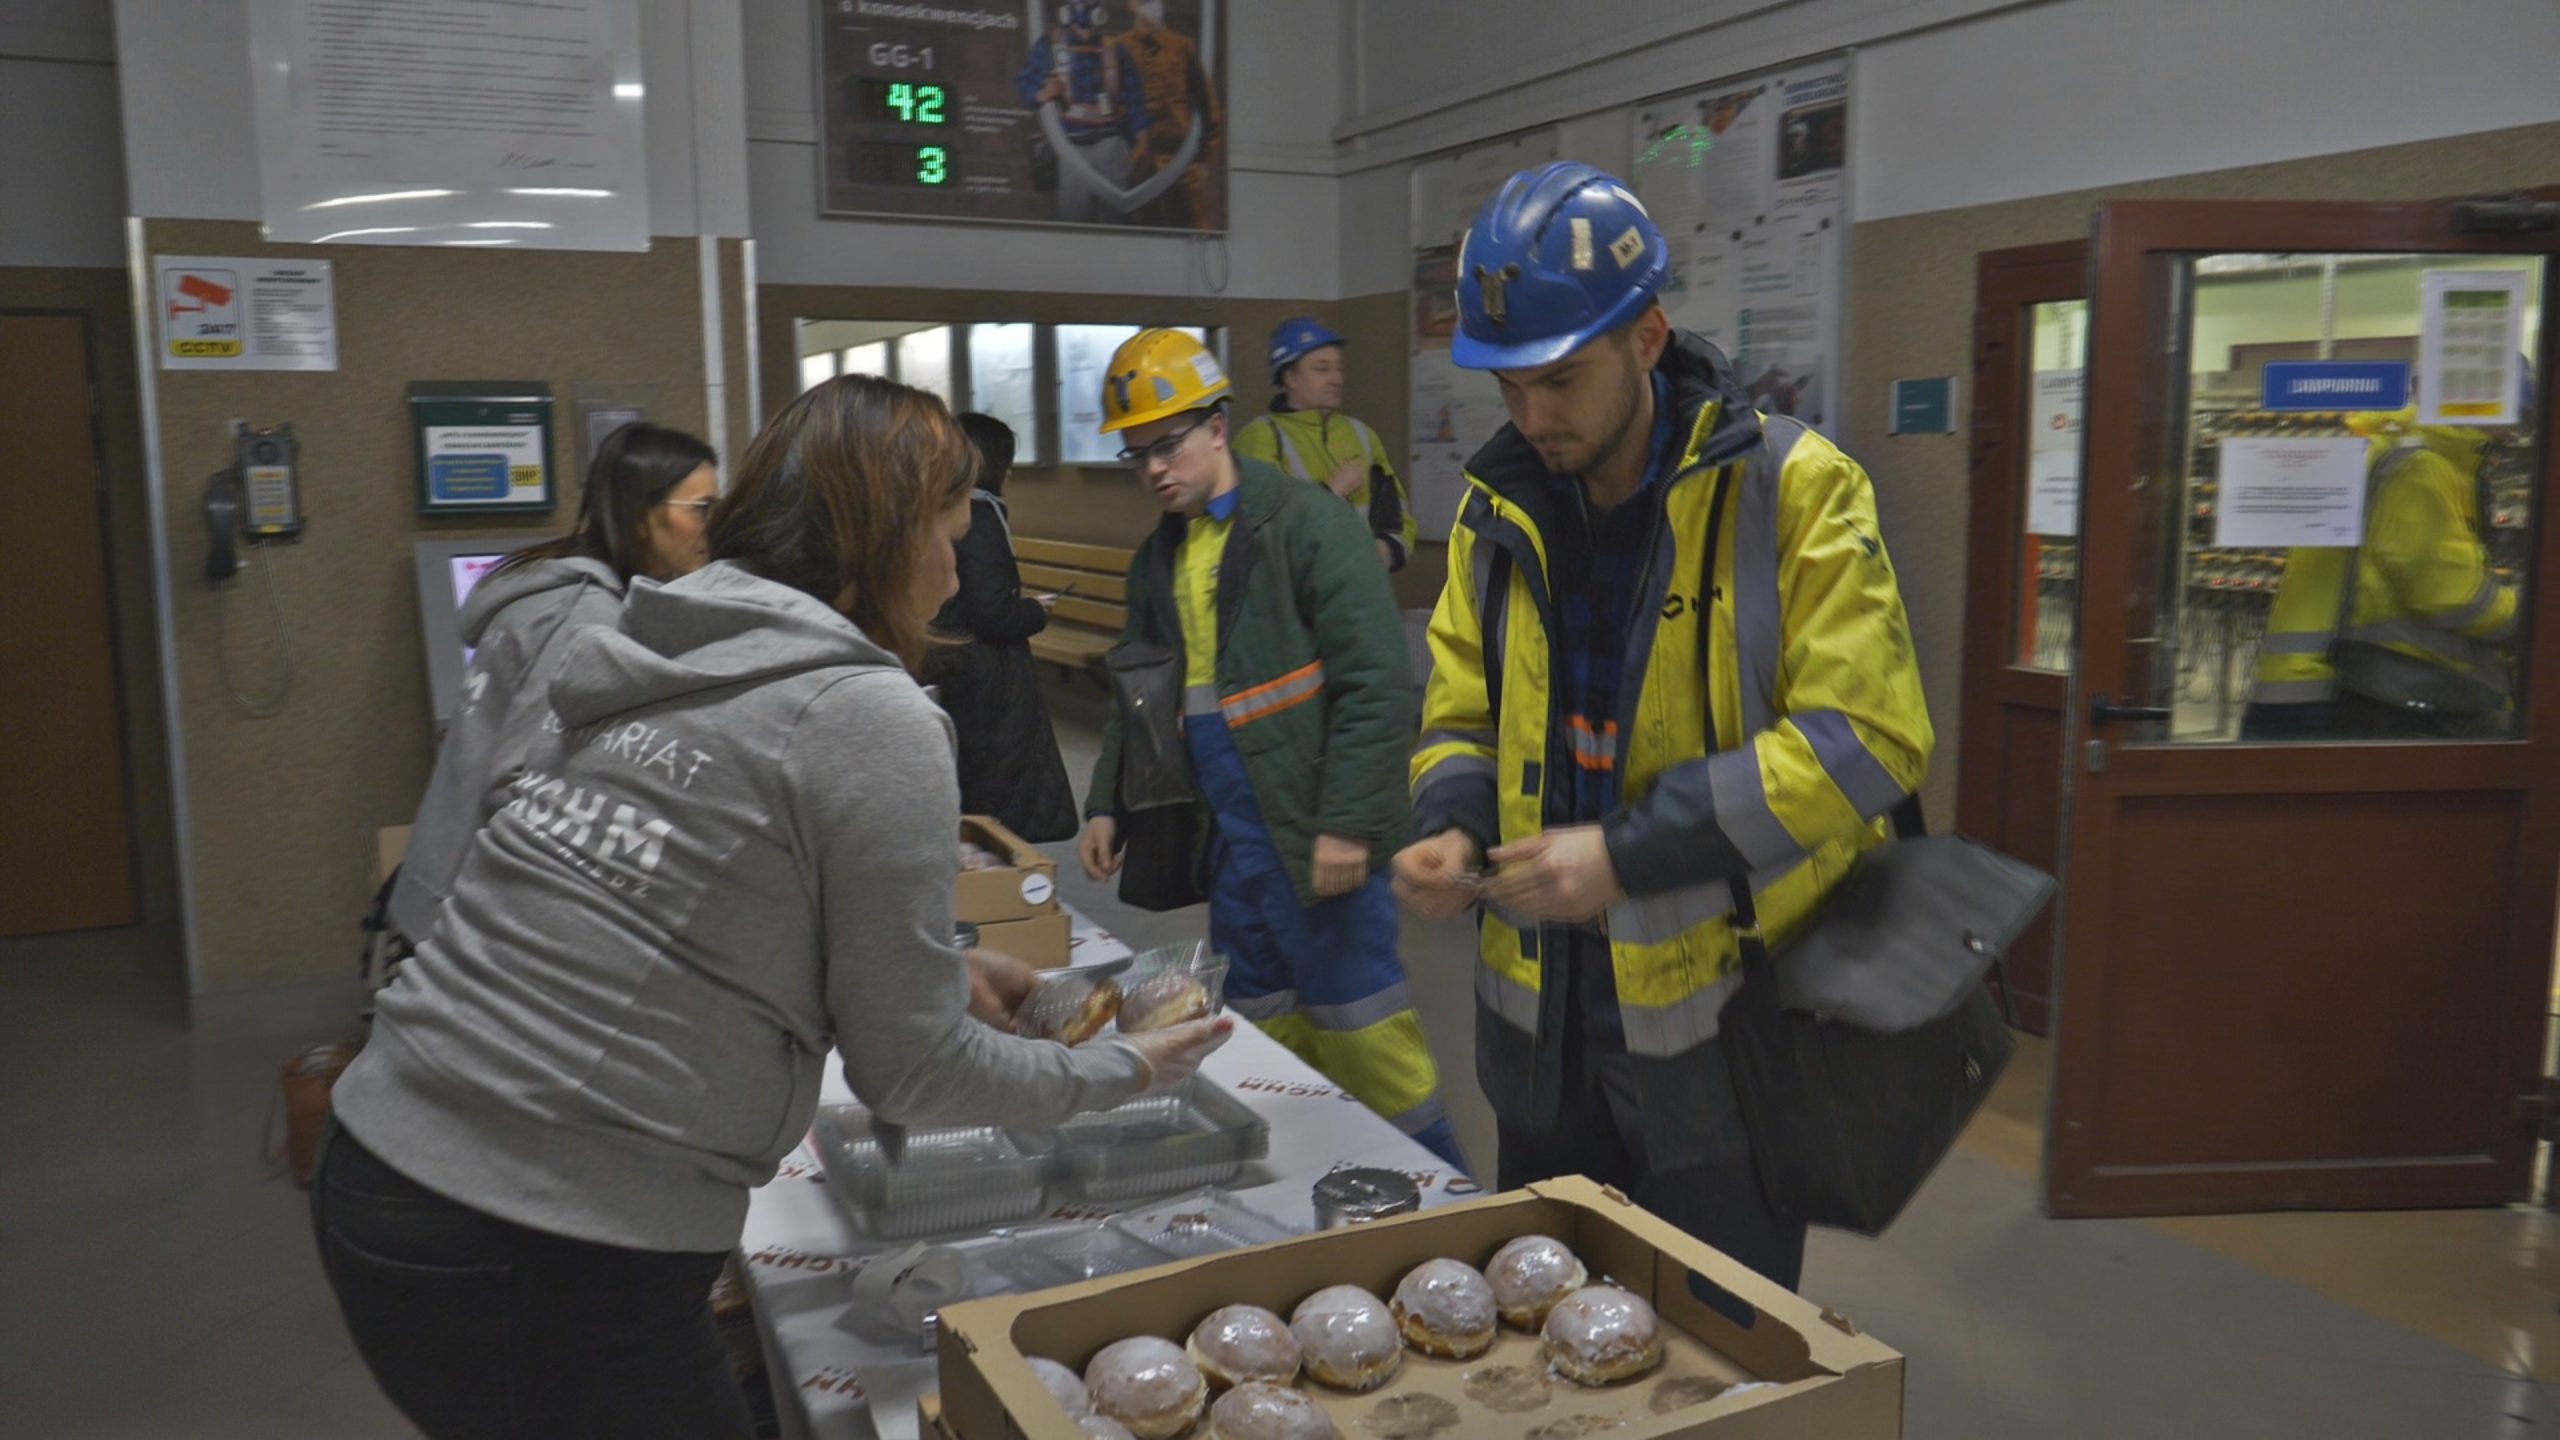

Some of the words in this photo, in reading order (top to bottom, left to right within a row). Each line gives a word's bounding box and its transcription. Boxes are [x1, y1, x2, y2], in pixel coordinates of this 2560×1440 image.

[869, 42, 934, 70] GG-1
[886, 83, 945, 123] 42
[917, 147, 946, 184] 3
[179, 342, 231, 353] CCTV
